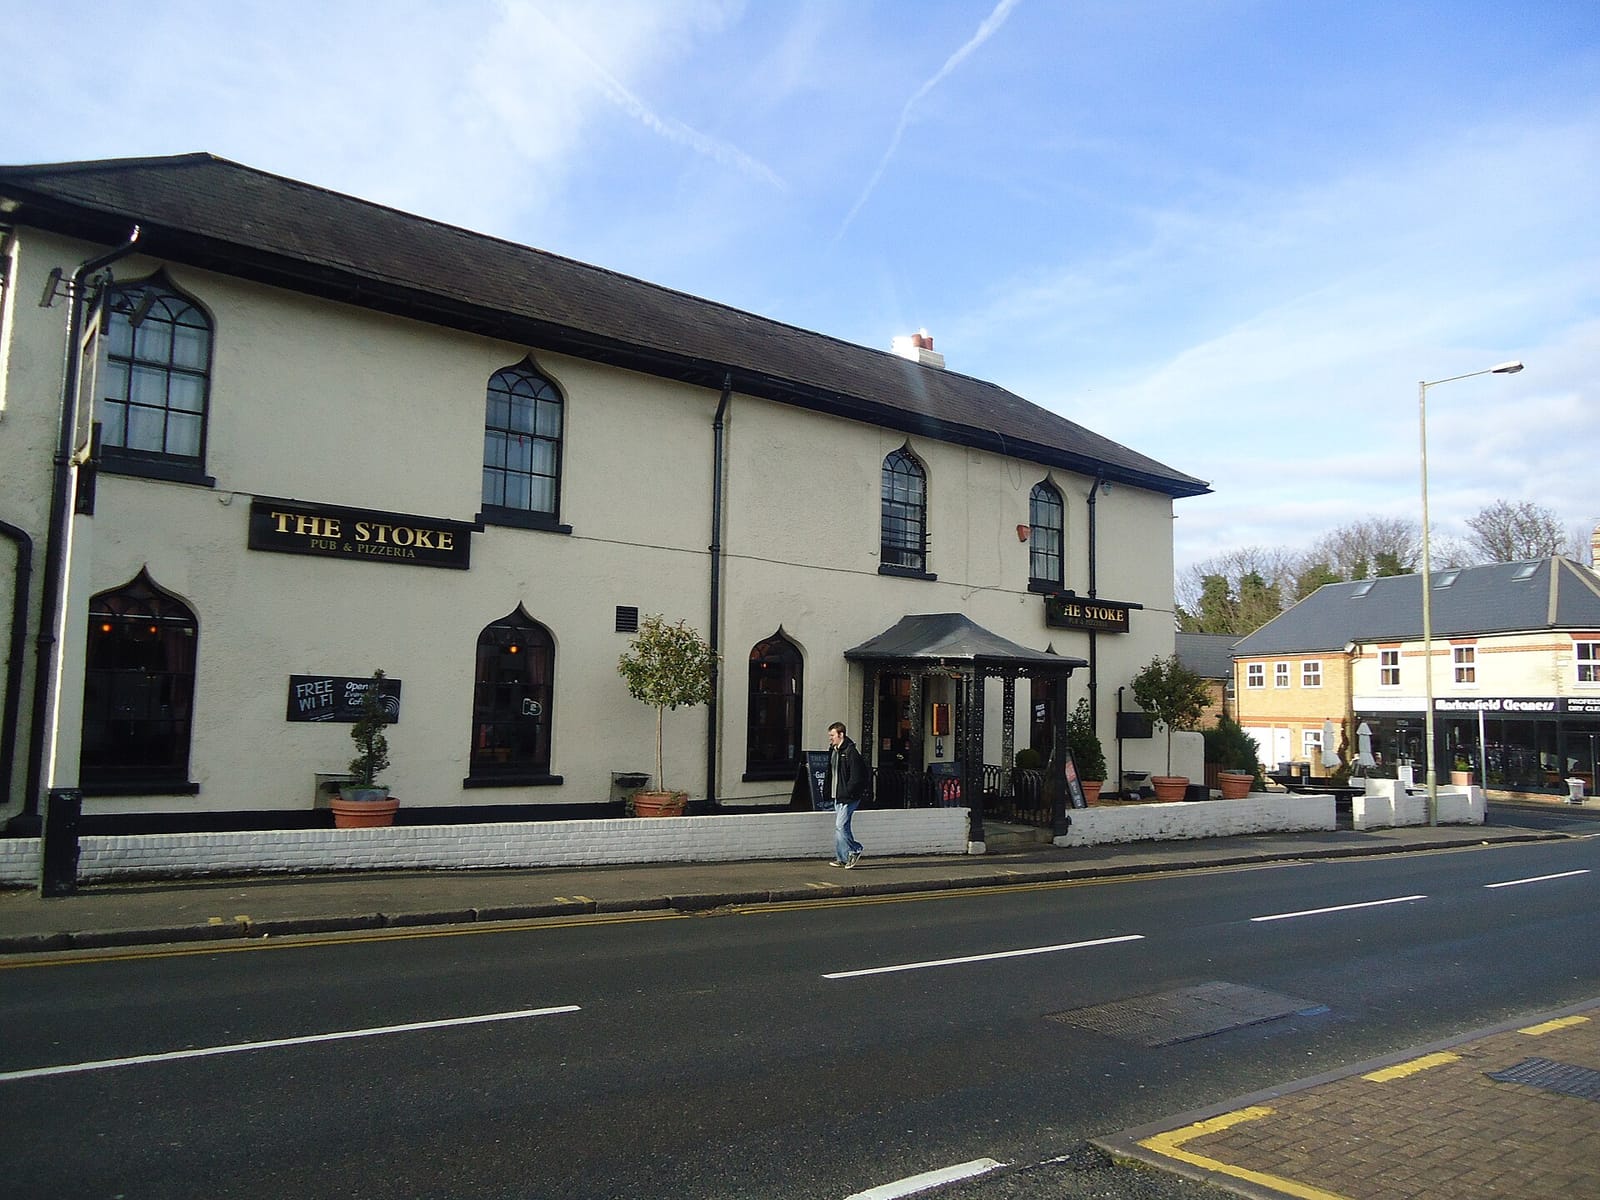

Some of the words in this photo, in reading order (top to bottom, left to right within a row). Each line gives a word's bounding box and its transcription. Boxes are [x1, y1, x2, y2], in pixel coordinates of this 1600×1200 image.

[271, 512, 342, 538] THE
[355, 522, 454, 551] STOKE
[311, 538, 337, 551] PUB
[343, 543, 353, 552] &
[357, 544, 416, 558] PIZZERIA
[1063, 604, 1081, 617] HE
[1084, 606, 1124, 622] STOKE
[296, 680, 334, 698] FREE
[346, 682, 369, 692] Open
[299, 697, 316, 712] WI
[320, 693, 333, 707] FI
[1502, 699, 1555, 711] Cleaners
